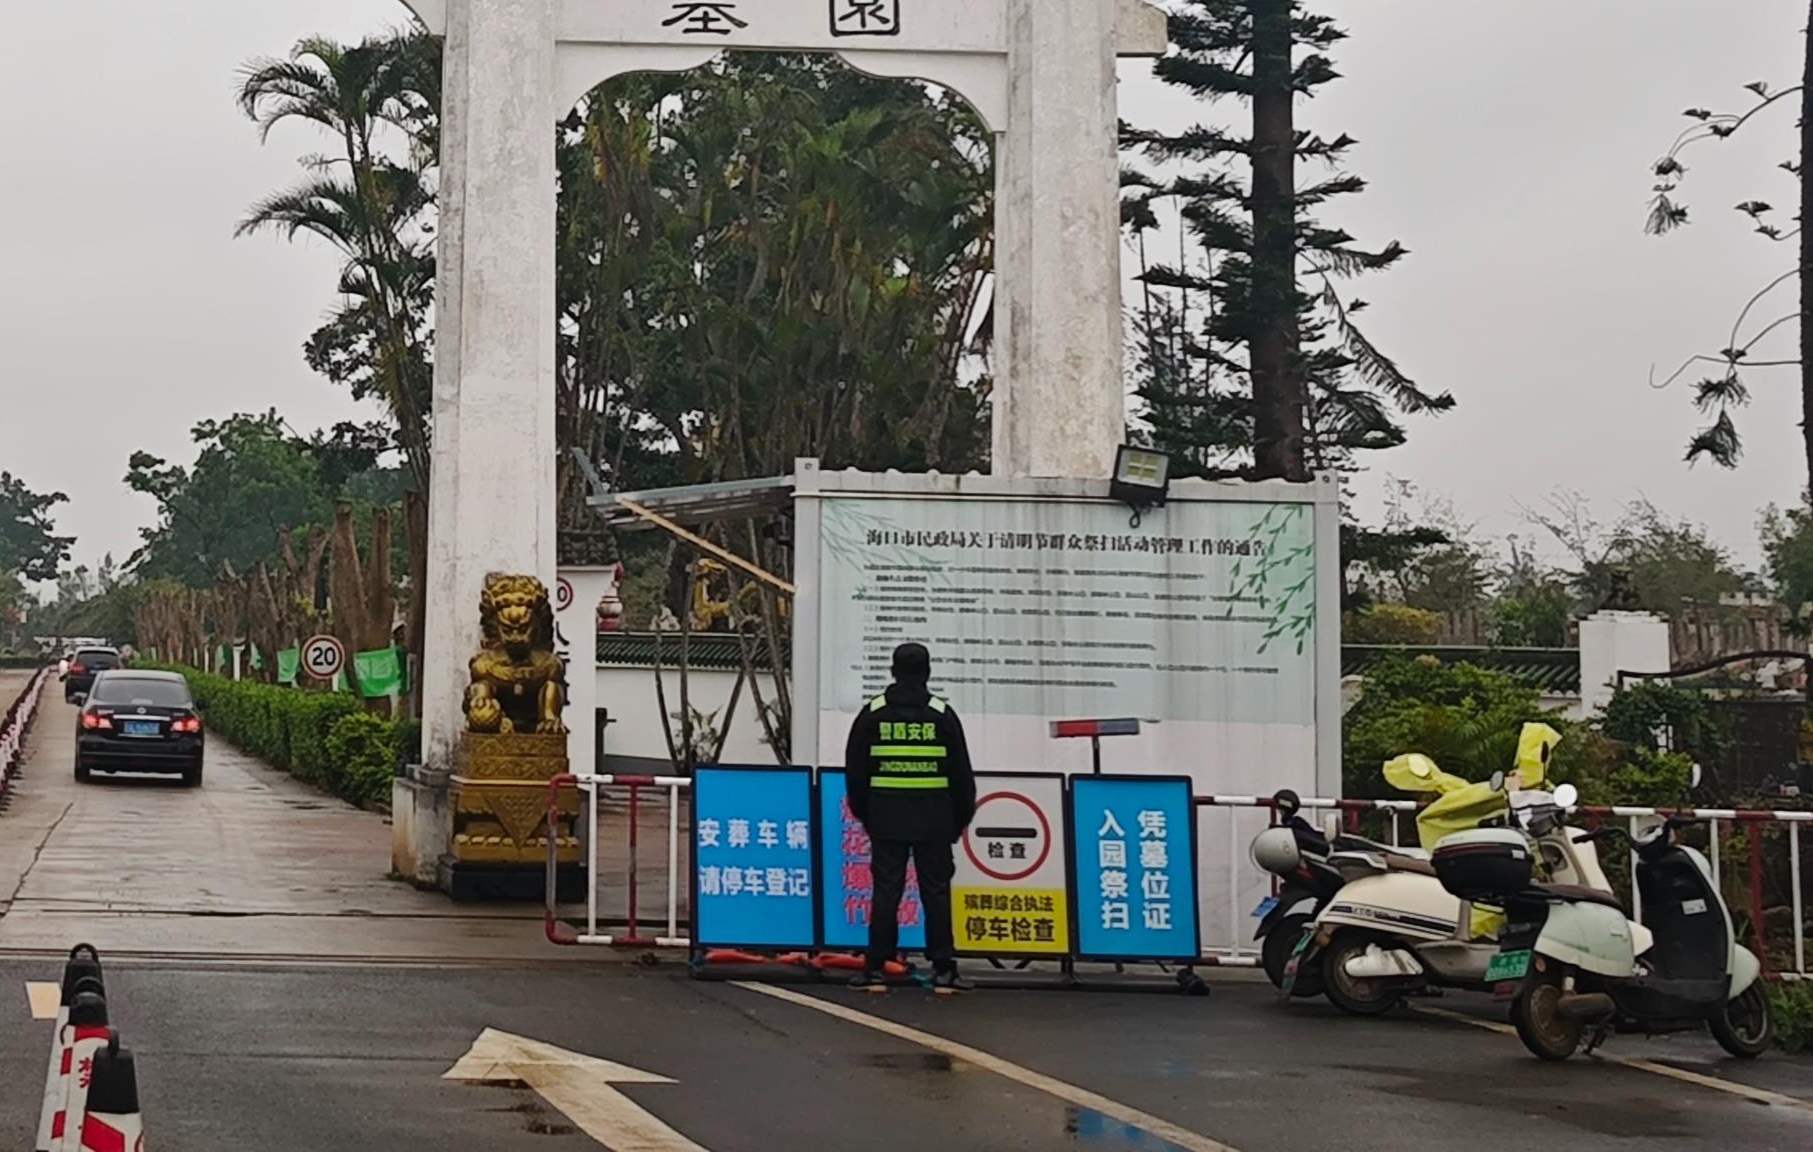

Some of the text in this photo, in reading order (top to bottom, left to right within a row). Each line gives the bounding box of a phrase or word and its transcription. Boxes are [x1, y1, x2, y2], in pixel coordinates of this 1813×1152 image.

[312, 646, 336, 666] 20
[698, 817, 809, 849] 安葬车辆
[987, 841, 1027, 859] 检查
[698, 865, 809, 896] 请停车登记
[1097, 808, 1130, 930] 入园祭扫
[1136, 809, 1172, 930] 凭墓位证
[964, 894, 1055, 912] 殡葬综合执法
[965, 916, 1055, 942] 停车检查
